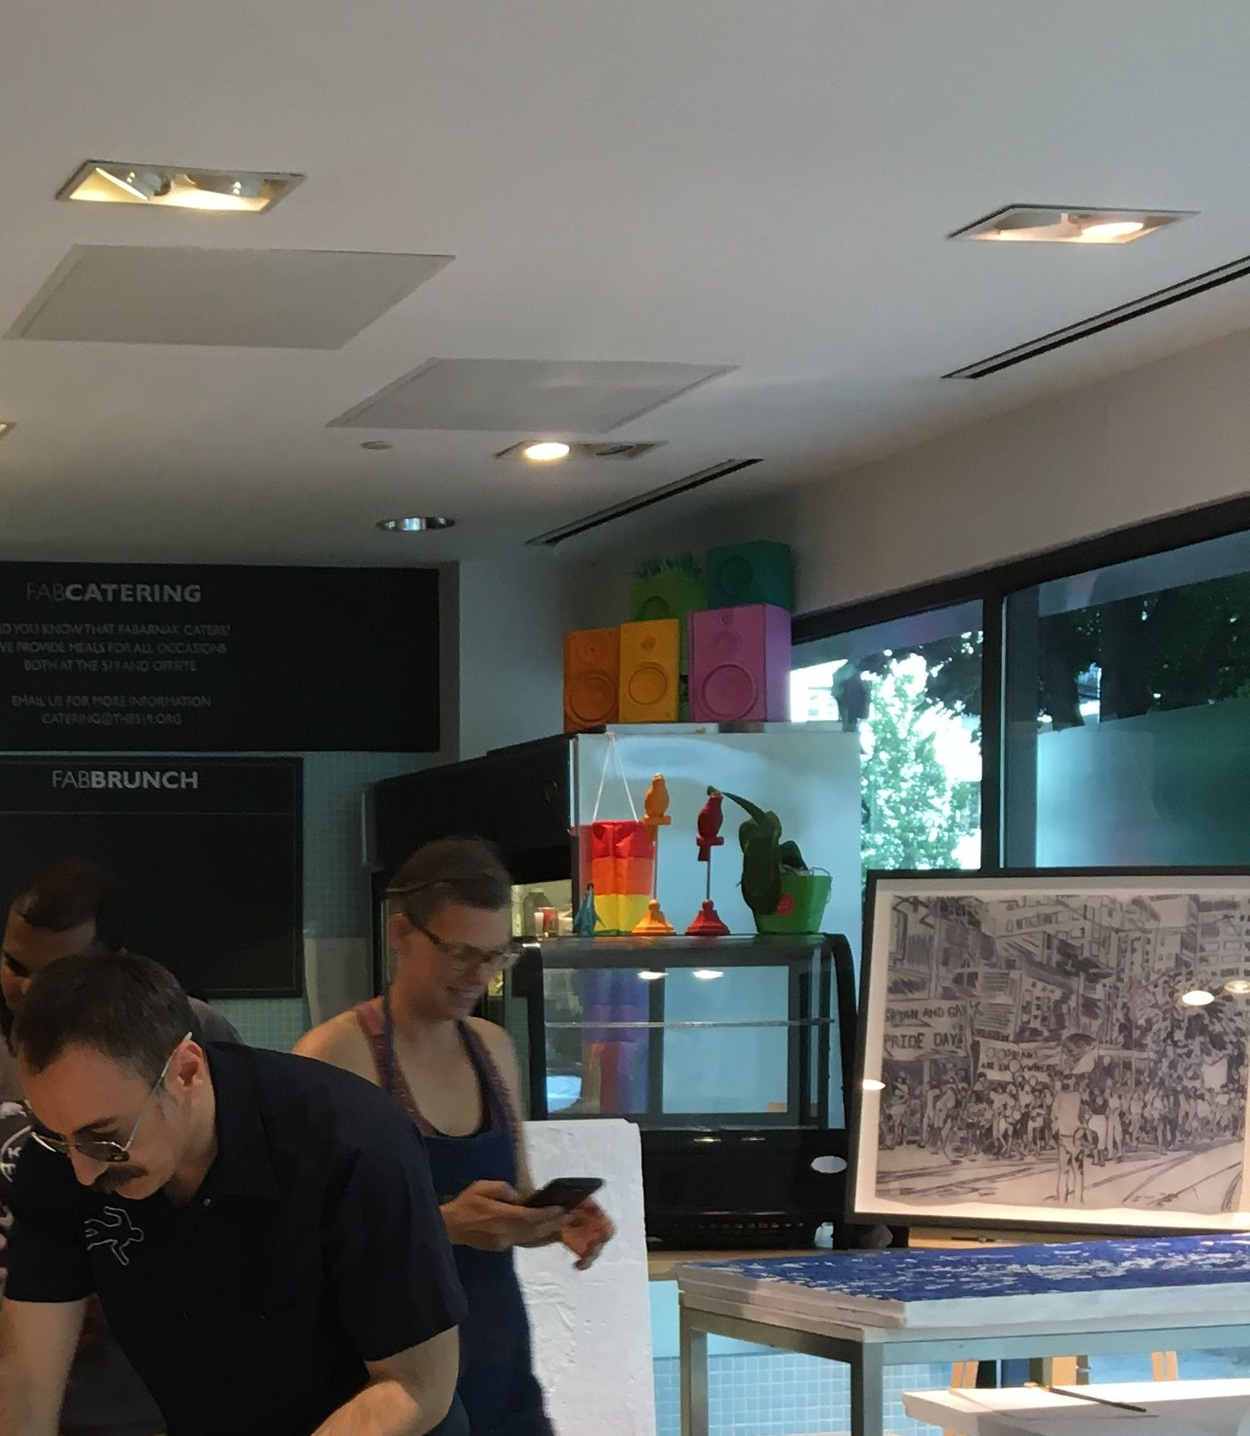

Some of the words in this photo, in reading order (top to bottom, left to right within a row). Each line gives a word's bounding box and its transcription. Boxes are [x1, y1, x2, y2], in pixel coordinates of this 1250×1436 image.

[26, 582, 201, 603] FABCATERING
[12, 623, 39, 635] YOU
[41, 623, 84, 635] KNOW
[84, 623, 115, 635] THAT
[117, 624, 180, 636] FABARNAK
[15, 641, 66, 653] PROVIDE
[68, 641, 105, 653] MEALS
[107, 642, 131, 654] FOR
[133, 642, 154, 654] ALL
[156, 642, 227, 654] OCCASIONS
[23, 659, 58, 671] BOTH
[59, 659, 74, 671] AT
[75, 659, 99, 671] THE
[120, 660, 150, 672] AND
[152, 660, 196, 672] OFFSITE
[10, 694, 45, 706] EMAIL
[48, 694, 63, 706] US
[65, 694, 90, 706] FOR
[91, 695, 126, 707] MORE
[128, 695, 212, 707] INFORMATION
[52, 770, 198, 789] FABBRUNCH
[922, 1006, 944, 1018] AND
[884, 1032, 925, 1049] PRIDE
